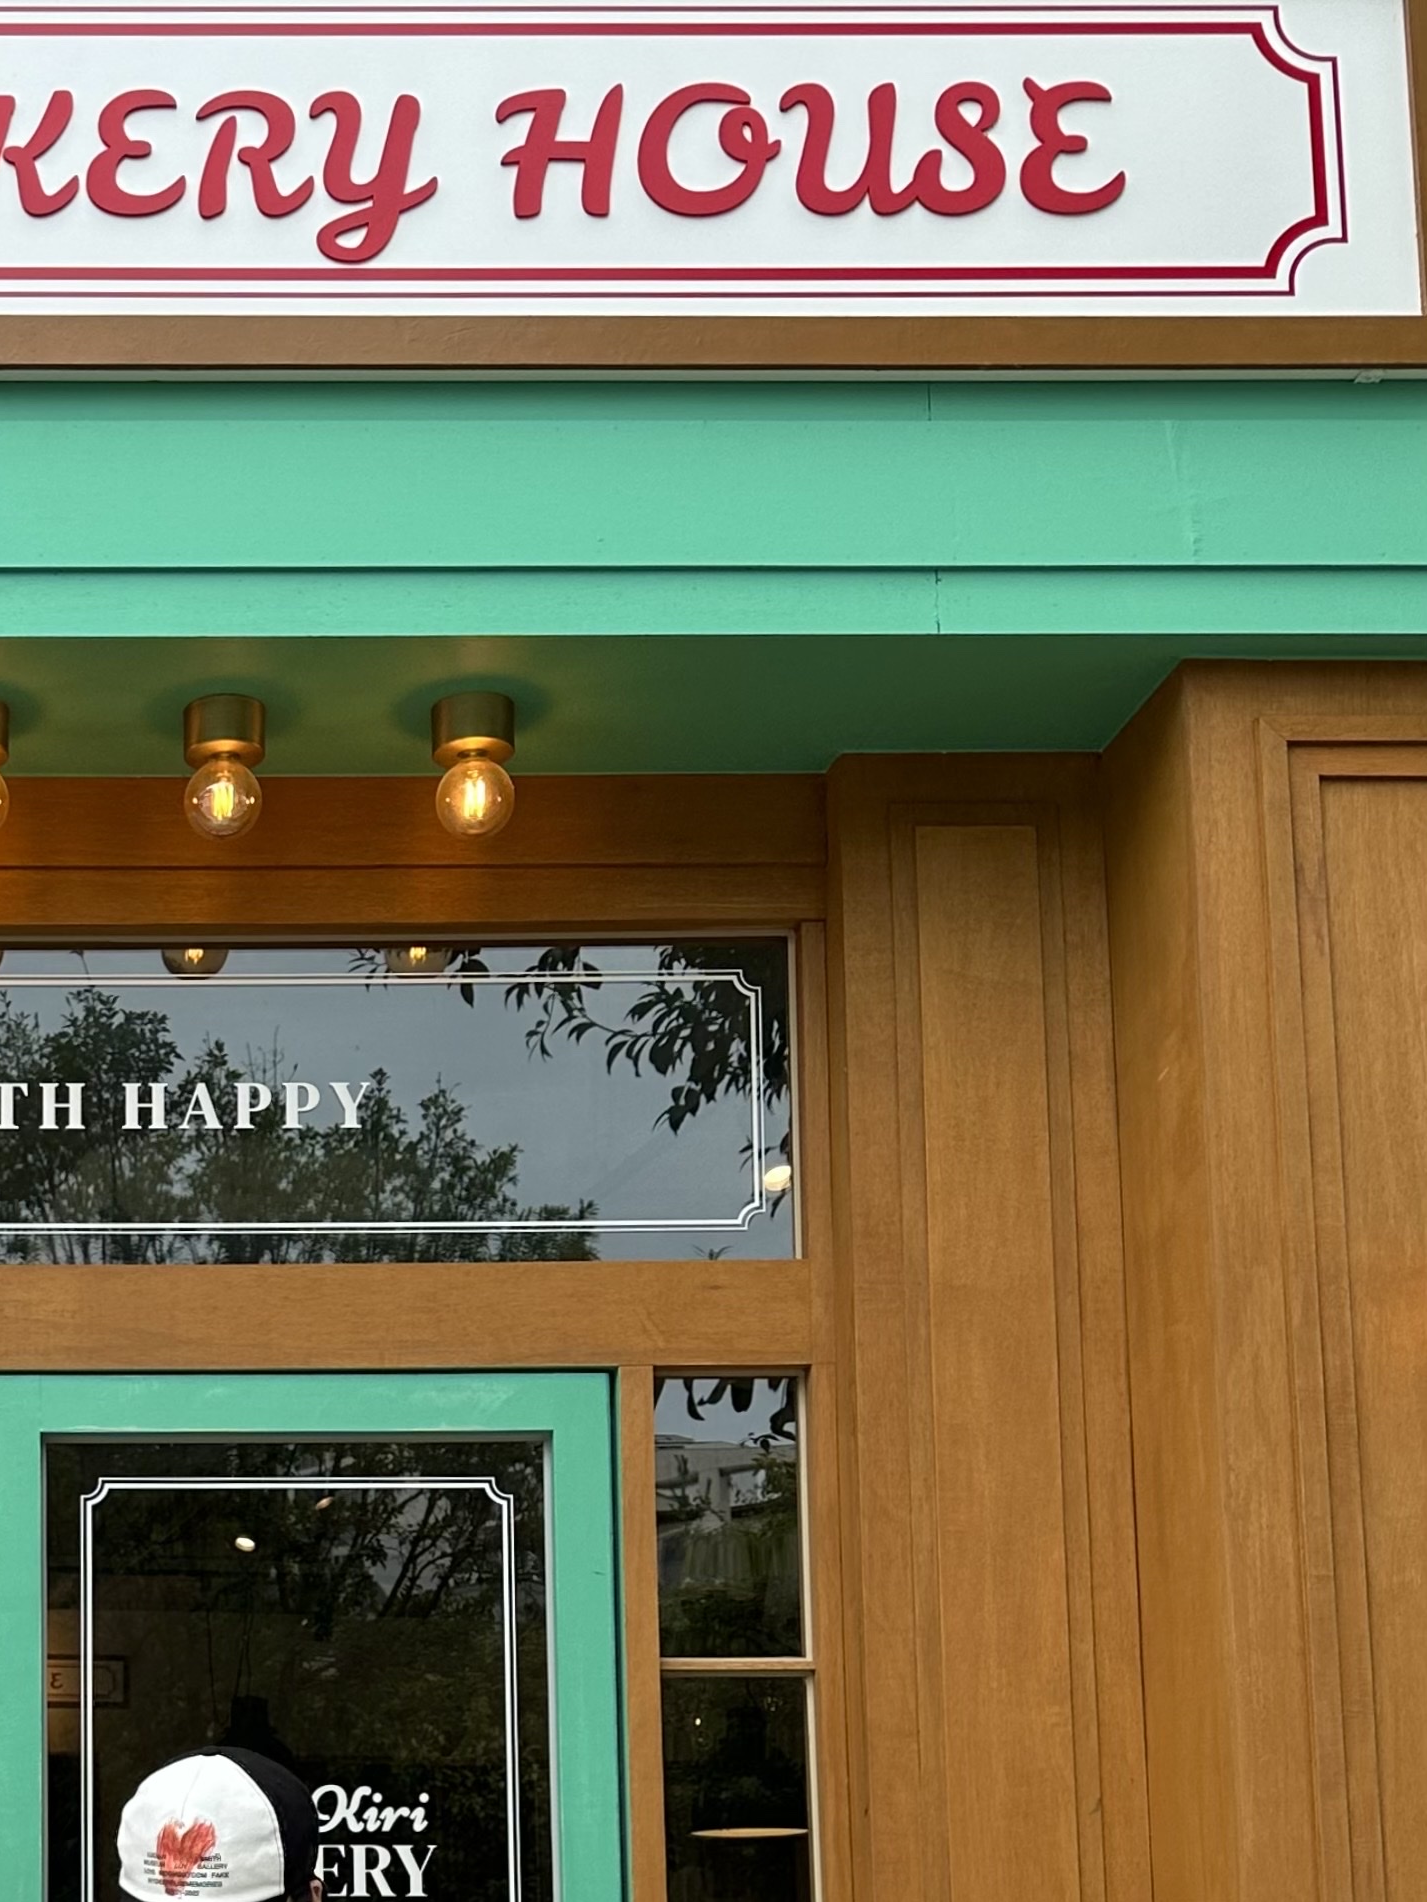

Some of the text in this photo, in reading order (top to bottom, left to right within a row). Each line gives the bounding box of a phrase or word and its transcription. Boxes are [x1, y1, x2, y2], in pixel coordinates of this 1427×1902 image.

[495, 77, 1126, 219] HOUSE
[121, 1080, 372, 1131] HAPPY
[313, 1844, 439, 1898] ERY
